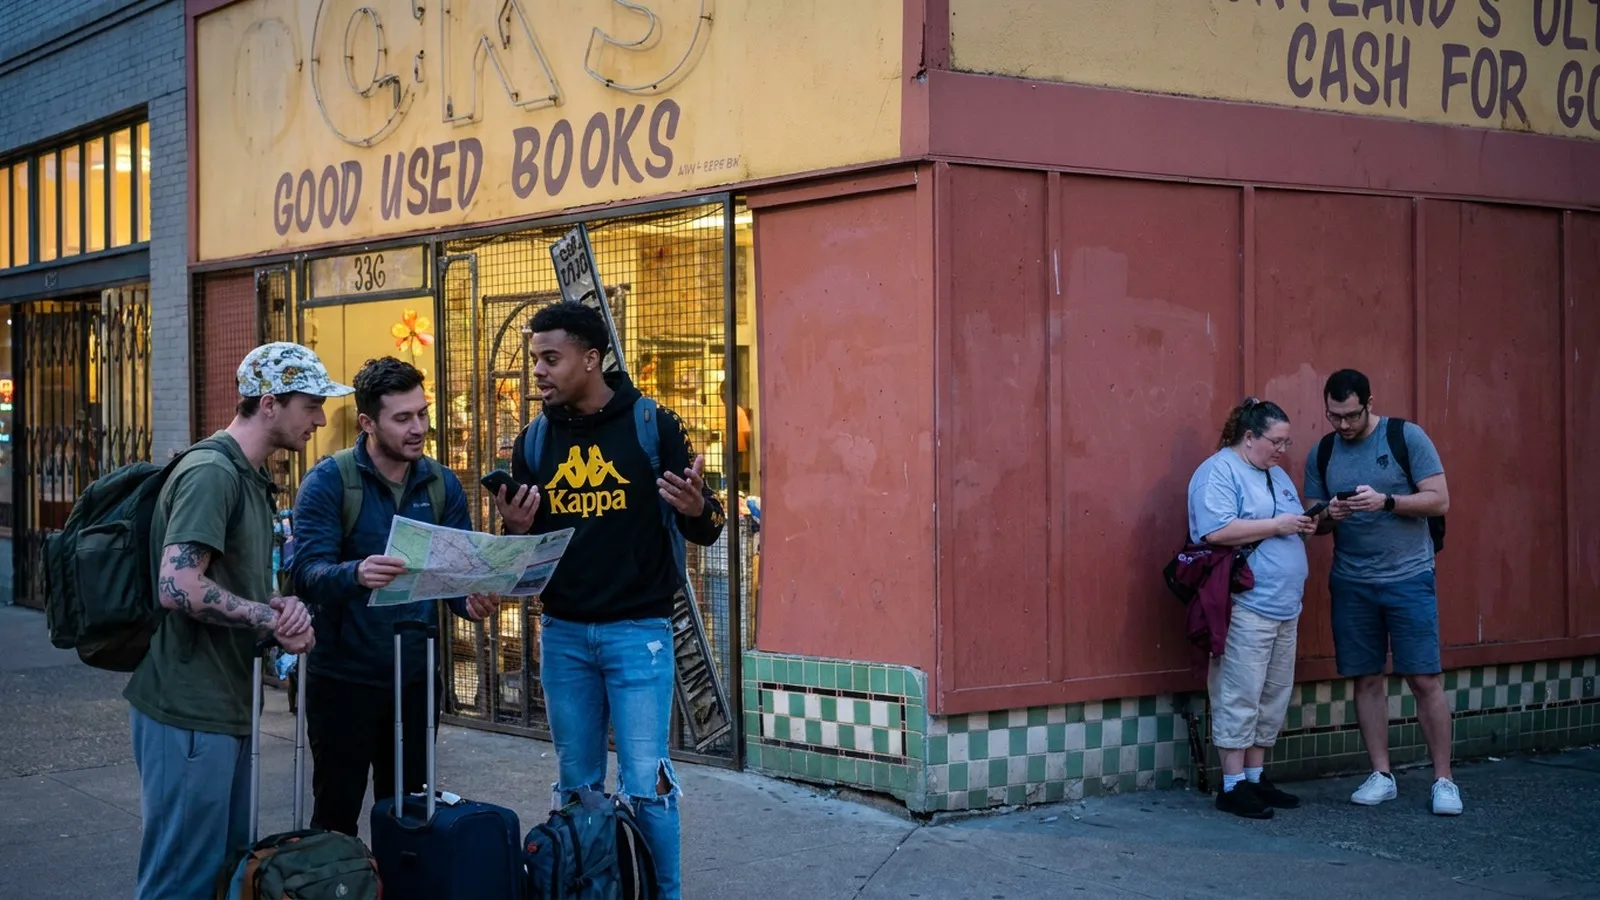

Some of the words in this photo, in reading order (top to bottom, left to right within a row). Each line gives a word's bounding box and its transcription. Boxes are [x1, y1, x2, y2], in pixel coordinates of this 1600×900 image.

[1287, 22, 1411, 109] CASH
[1441, 43, 1531, 128] FOR
[274, 160, 362, 236] GOOD
[380, 137, 484, 220] USED
[511, 98, 681, 199] BOOKS
[549, 489, 627, 518] Kappa
